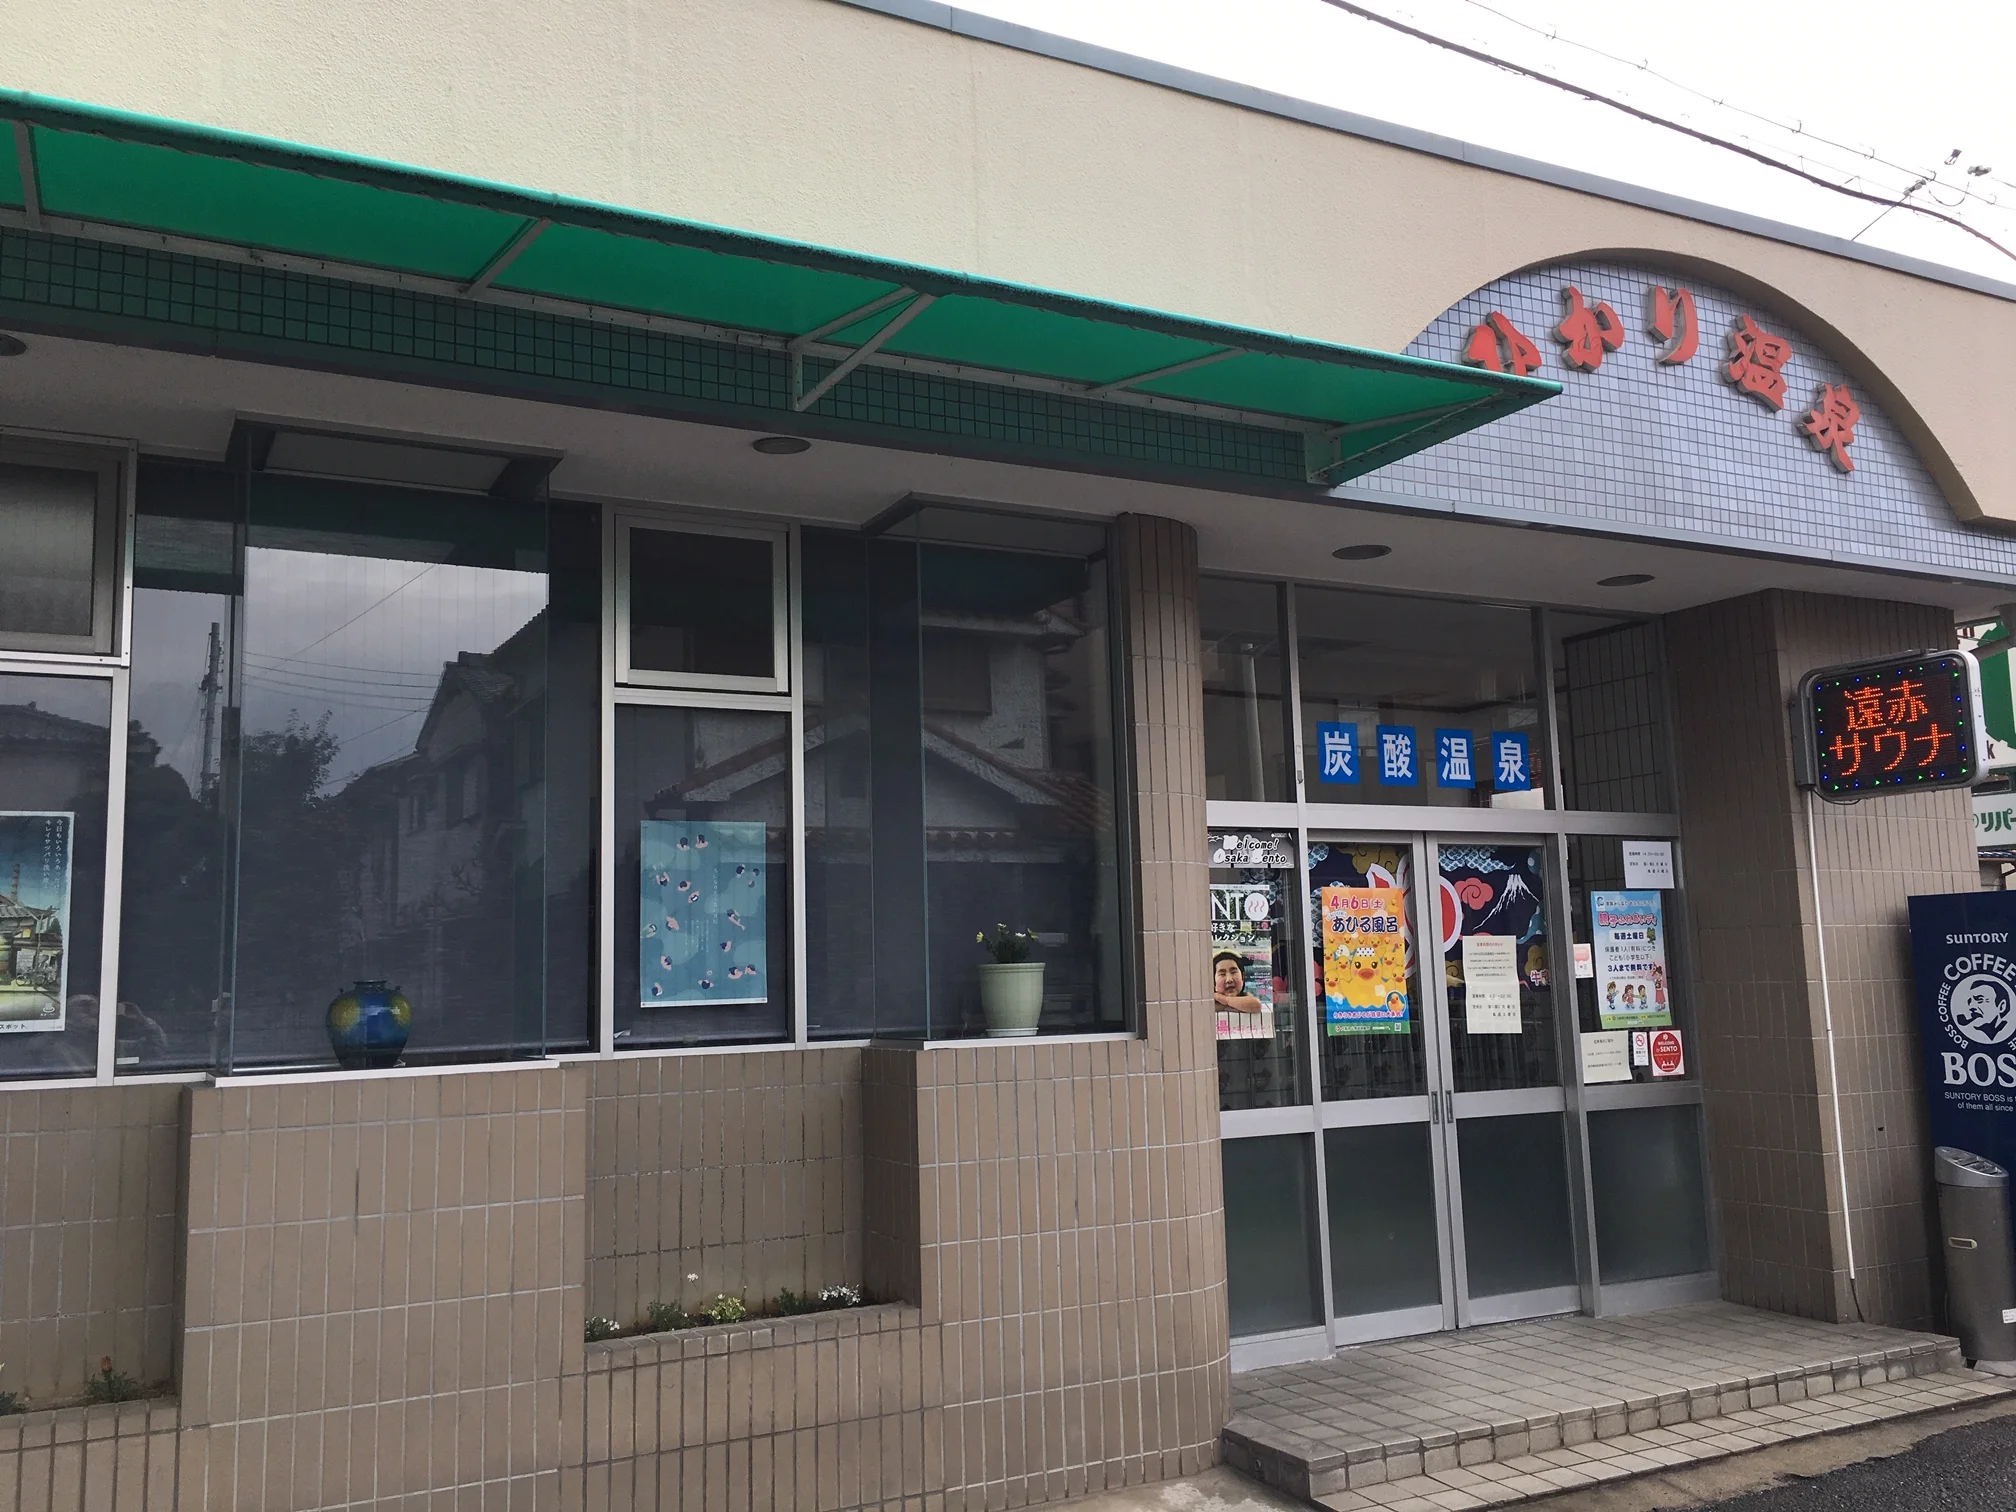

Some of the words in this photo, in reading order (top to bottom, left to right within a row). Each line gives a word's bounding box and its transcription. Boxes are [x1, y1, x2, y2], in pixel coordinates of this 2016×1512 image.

[1461, 285, 1861, 474] ひかり温泉
[1844, 680, 1929, 731] 遠赤
[1323, 730, 1527, 784] 炭酸温泉
[1829, 723, 1953, 776] サウナ
[1332, 915, 1399, 933] あひる風呂
[1613, 931, 1645, 941] 毎週土曜日
[1943, 953, 2016, 981] COFFEE
[1937, 982, 1952, 1022] COFFEE
[1944, 1023, 1969, 1050] BOSS
[1944, 1091, 1982, 1101] SUNTORY
[1983, 1093, 2006, 1102] BOSS
[1957, 1101, 1965, 1109] of
[1965, 1101, 1984, 1110] them
[1984, 1103, 1994, 1111] all
[1994, 1104, 2014, 1112] since
